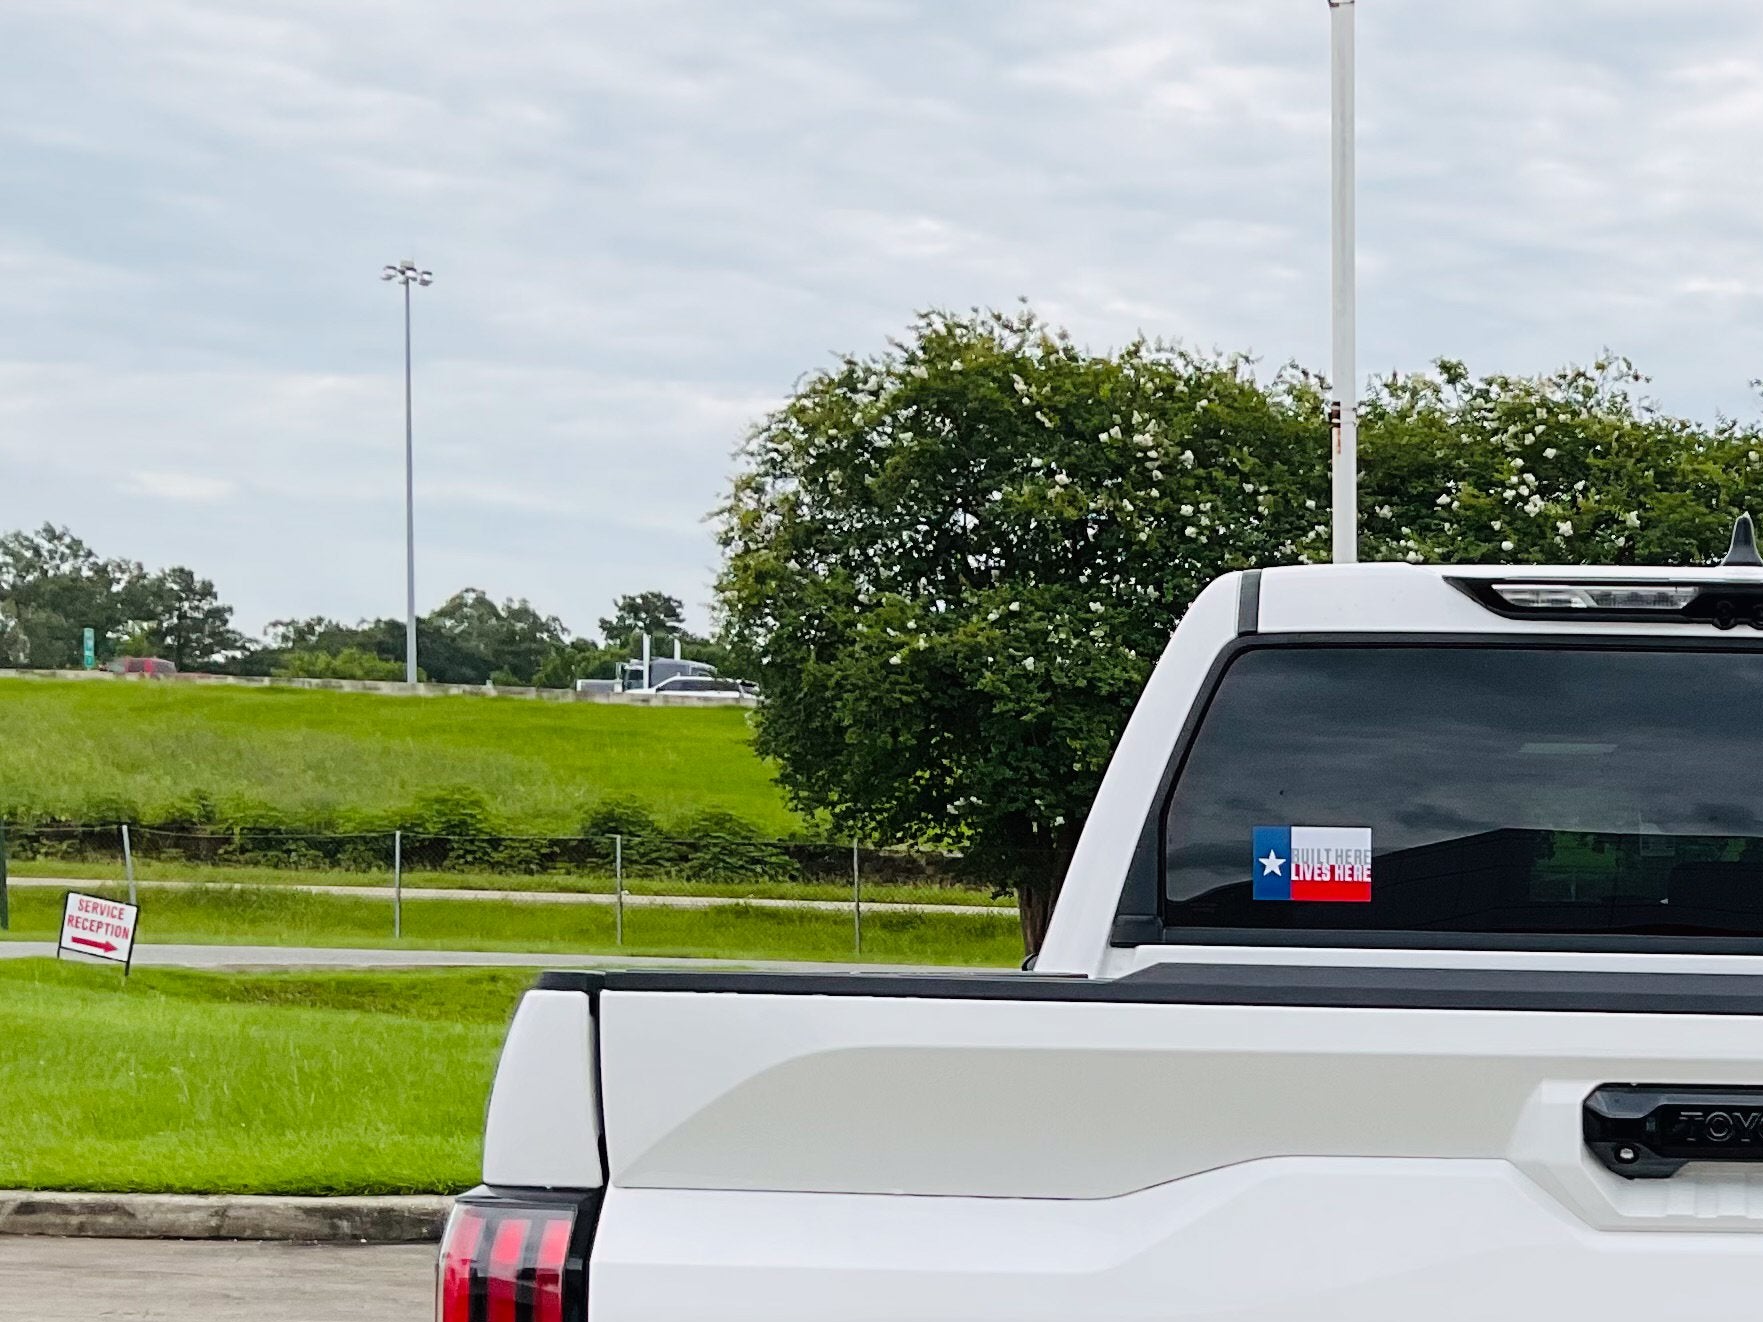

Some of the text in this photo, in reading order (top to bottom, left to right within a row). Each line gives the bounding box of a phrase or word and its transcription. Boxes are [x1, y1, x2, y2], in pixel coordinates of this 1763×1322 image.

[1291, 848, 1371, 865] BUILT HERE
[1291, 864, 1371, 882] LIVES HERE
[78, 899, 125, 920] SERVICE
[67, 915, 130, 939] RECEPTION
